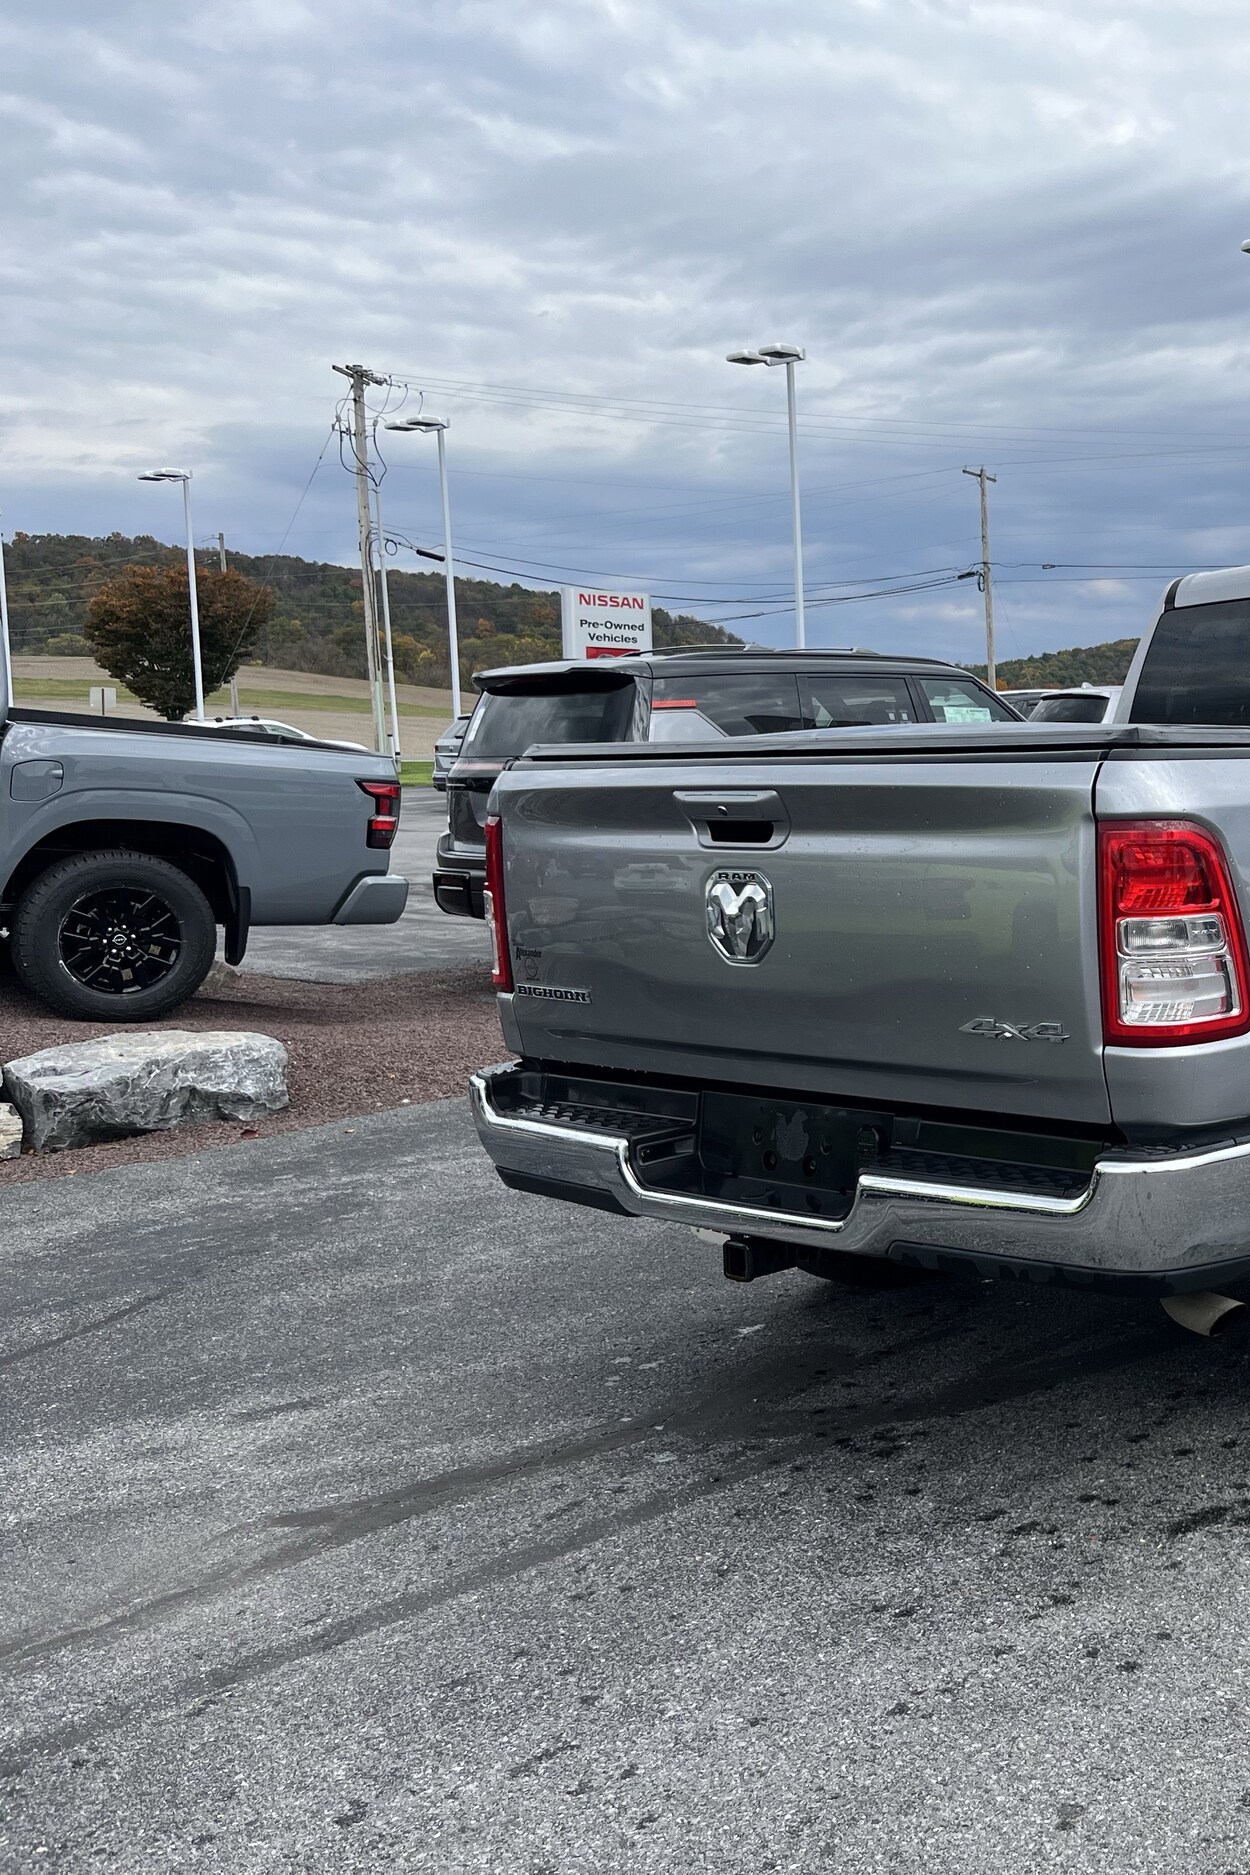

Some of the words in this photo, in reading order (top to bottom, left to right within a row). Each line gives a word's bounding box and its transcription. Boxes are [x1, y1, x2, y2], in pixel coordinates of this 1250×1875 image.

[579, 593, 644, 610] NISSAN
[580, 619, 645, 631] Pre-Owned
[588, 632, 638, 644] Vehicles
[718, 872, 756, 880] RAM
[517, 985, 590, 1003] BIGHORN
